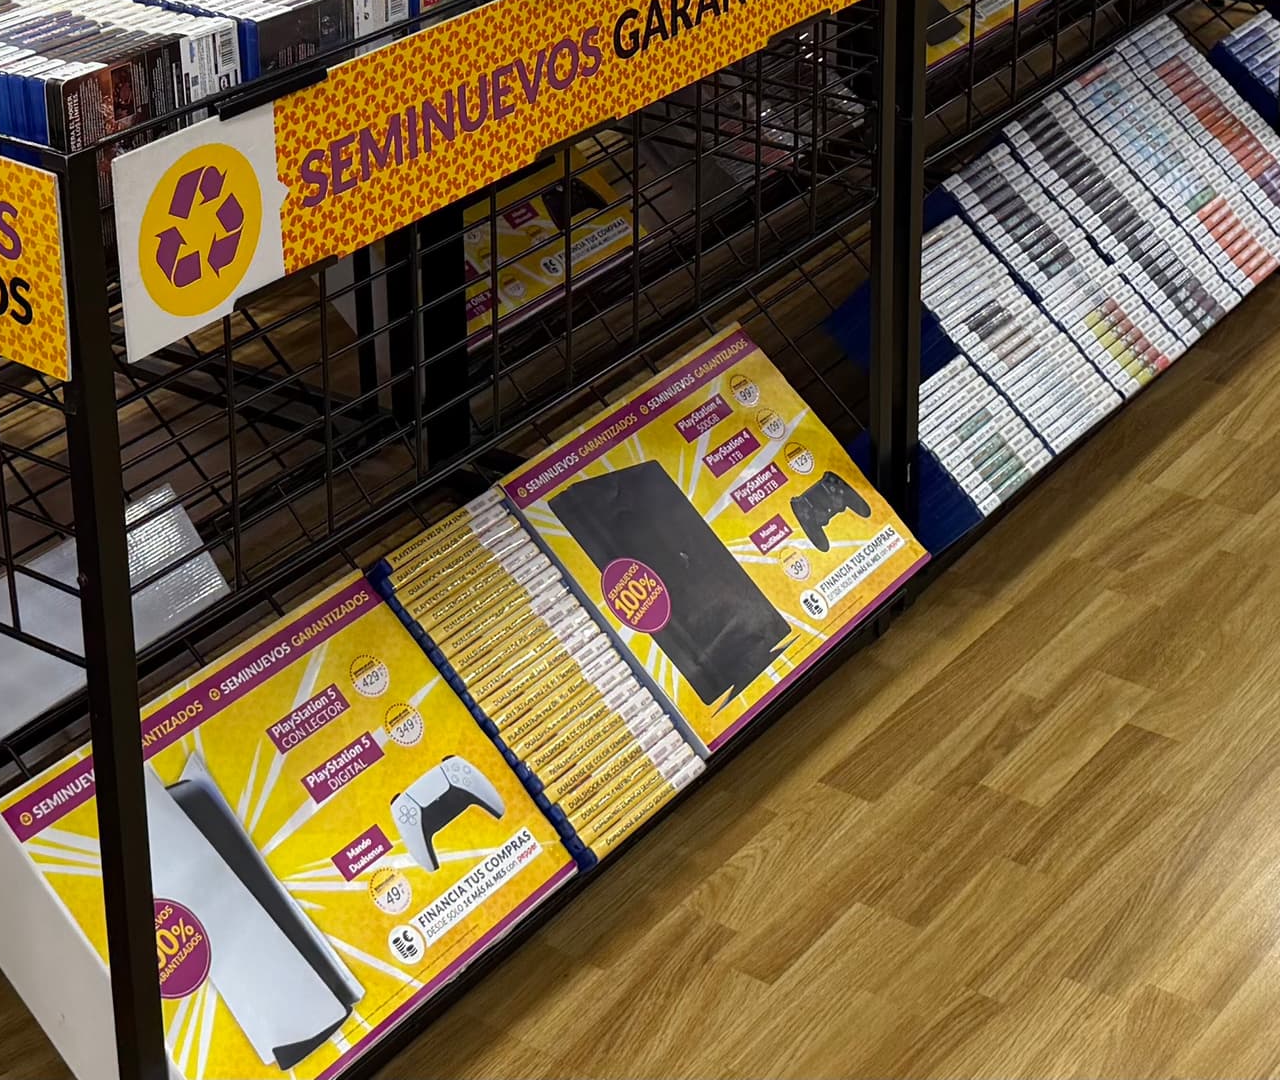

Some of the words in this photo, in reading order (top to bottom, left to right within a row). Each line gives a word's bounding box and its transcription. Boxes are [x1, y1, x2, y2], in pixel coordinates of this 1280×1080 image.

[300, 25, 603, 209] SEMINUEVOS
[615, 572, 656, 620] 100%
[221, 641, 292, 695] SEMINUEVOS
[290, 590, 370, 647] GARANTIZADOS
[271, 693, 327, 738] PlayStation
[327, 689, 336, 700] 5
[281, 728, 305, 749] CON
[305, 701, 344, 733] LECTOR
[306, 743, 361, 788] PlayStation
[362, 737, 371, 749] 5
[327, 760, 369, 791] DIGITAL
[346, 838, 372, 859] Mando
[348, 844, 384, 874] Dualsense
[418, 885, 465, 928] FINANCIA
[465, 868, 486, 888] TUS
[484, 830, 531, 871] COMPRAS
